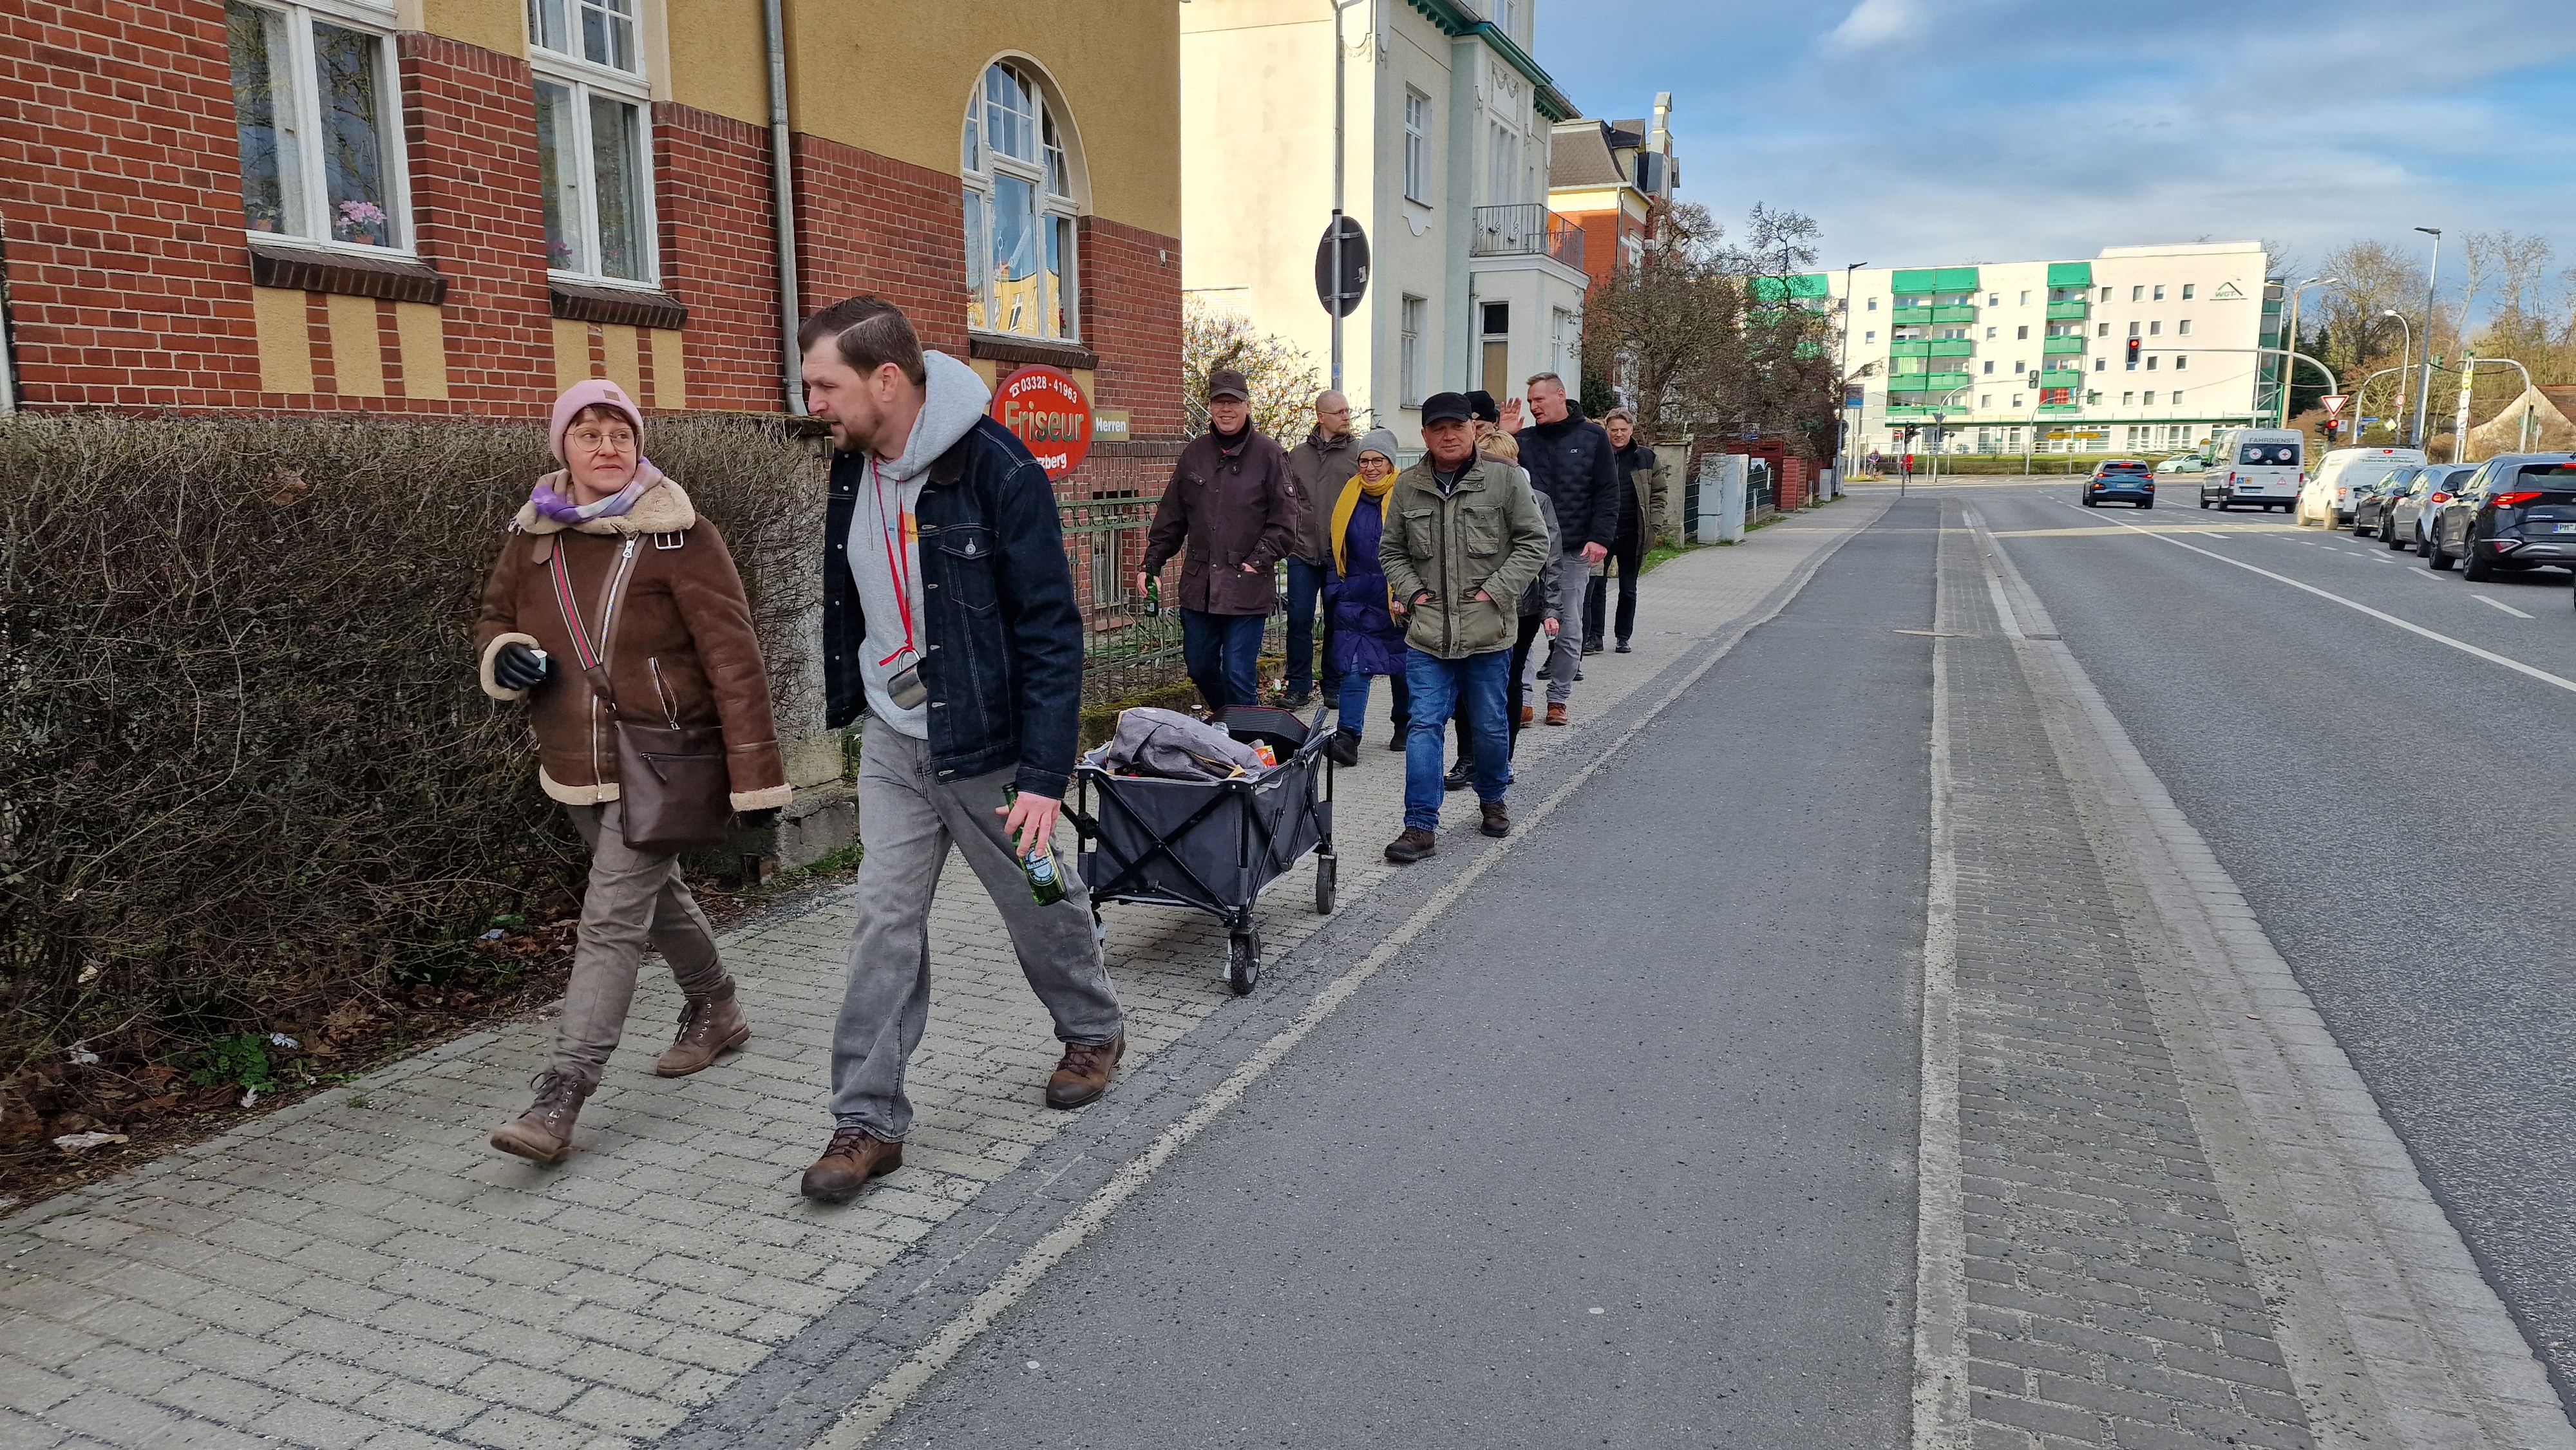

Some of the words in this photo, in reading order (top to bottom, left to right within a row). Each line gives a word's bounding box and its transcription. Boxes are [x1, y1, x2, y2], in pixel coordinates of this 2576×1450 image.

[1021, 375, 1047, 392] 03328
[1054, 379, 1077, 404] 41963
[1005, 400, 1084, 442] Friseur
[1095, 417, 1126, 433] Herren
